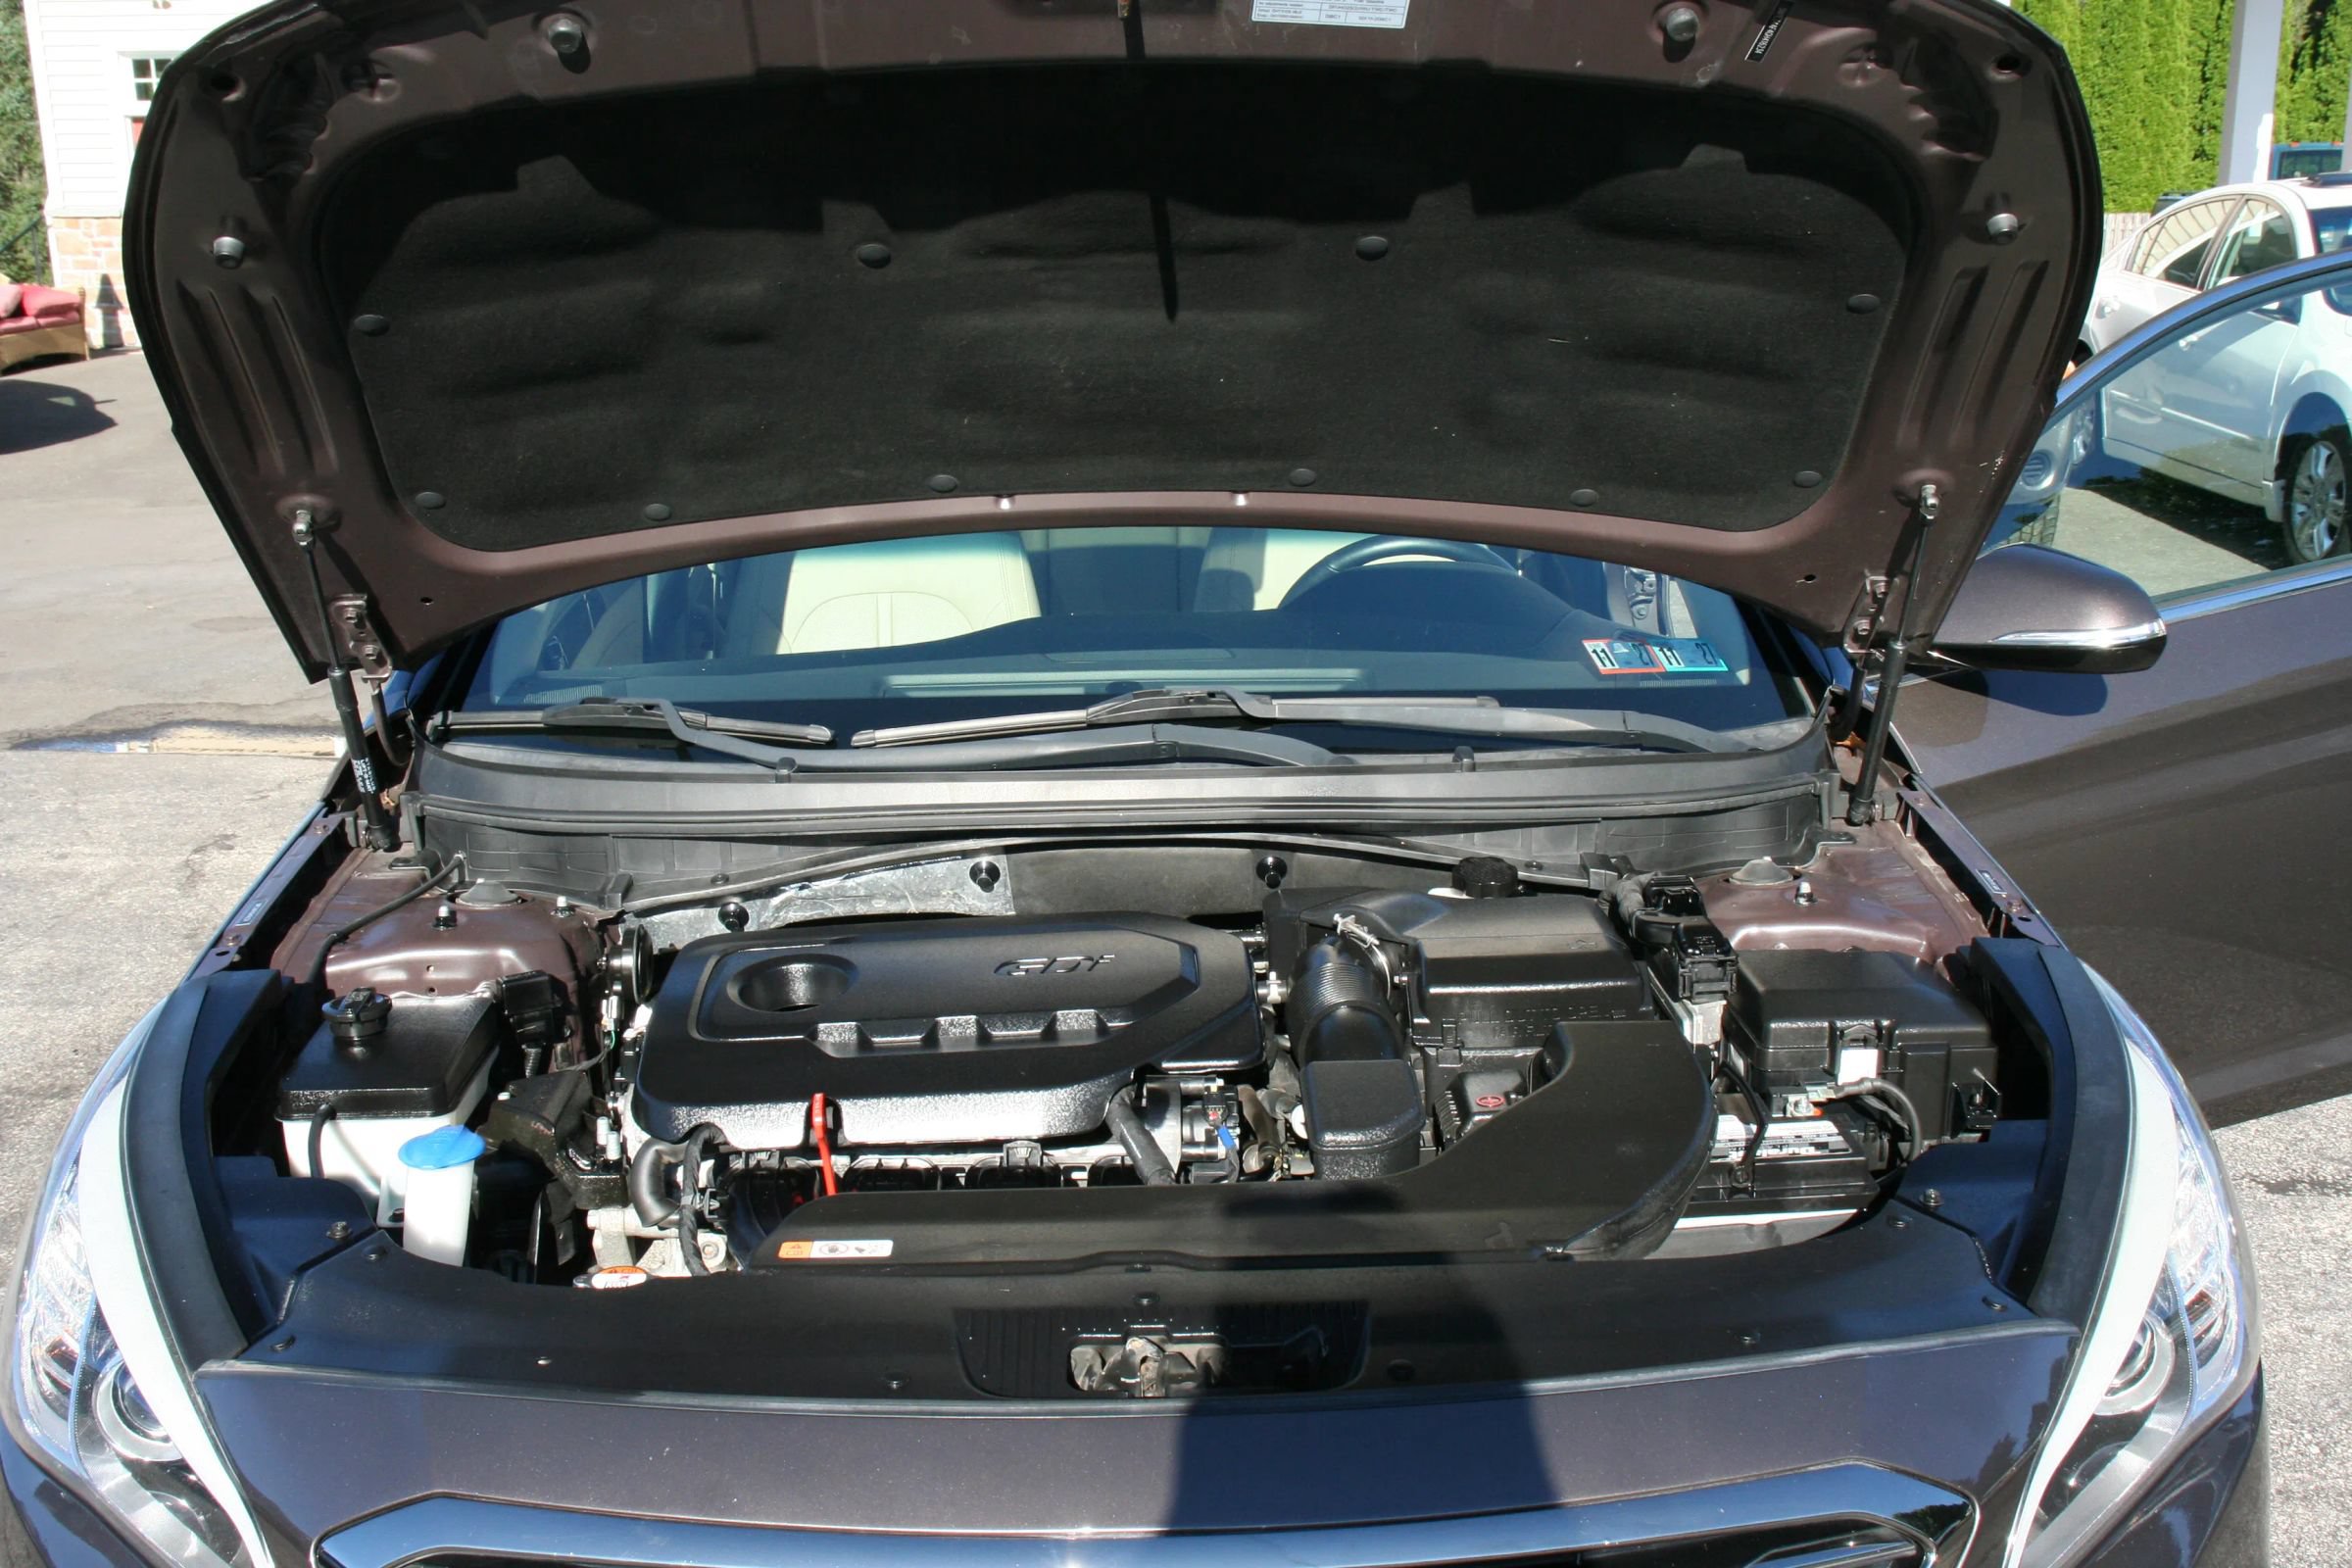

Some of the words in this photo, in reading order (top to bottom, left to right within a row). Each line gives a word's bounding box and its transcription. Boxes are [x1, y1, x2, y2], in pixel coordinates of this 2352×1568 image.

[1592, 648, 1615, 666] 11
[1658, 647, 1682, 665] 11
[1729, 1146, 1816, 1159] Duralt
